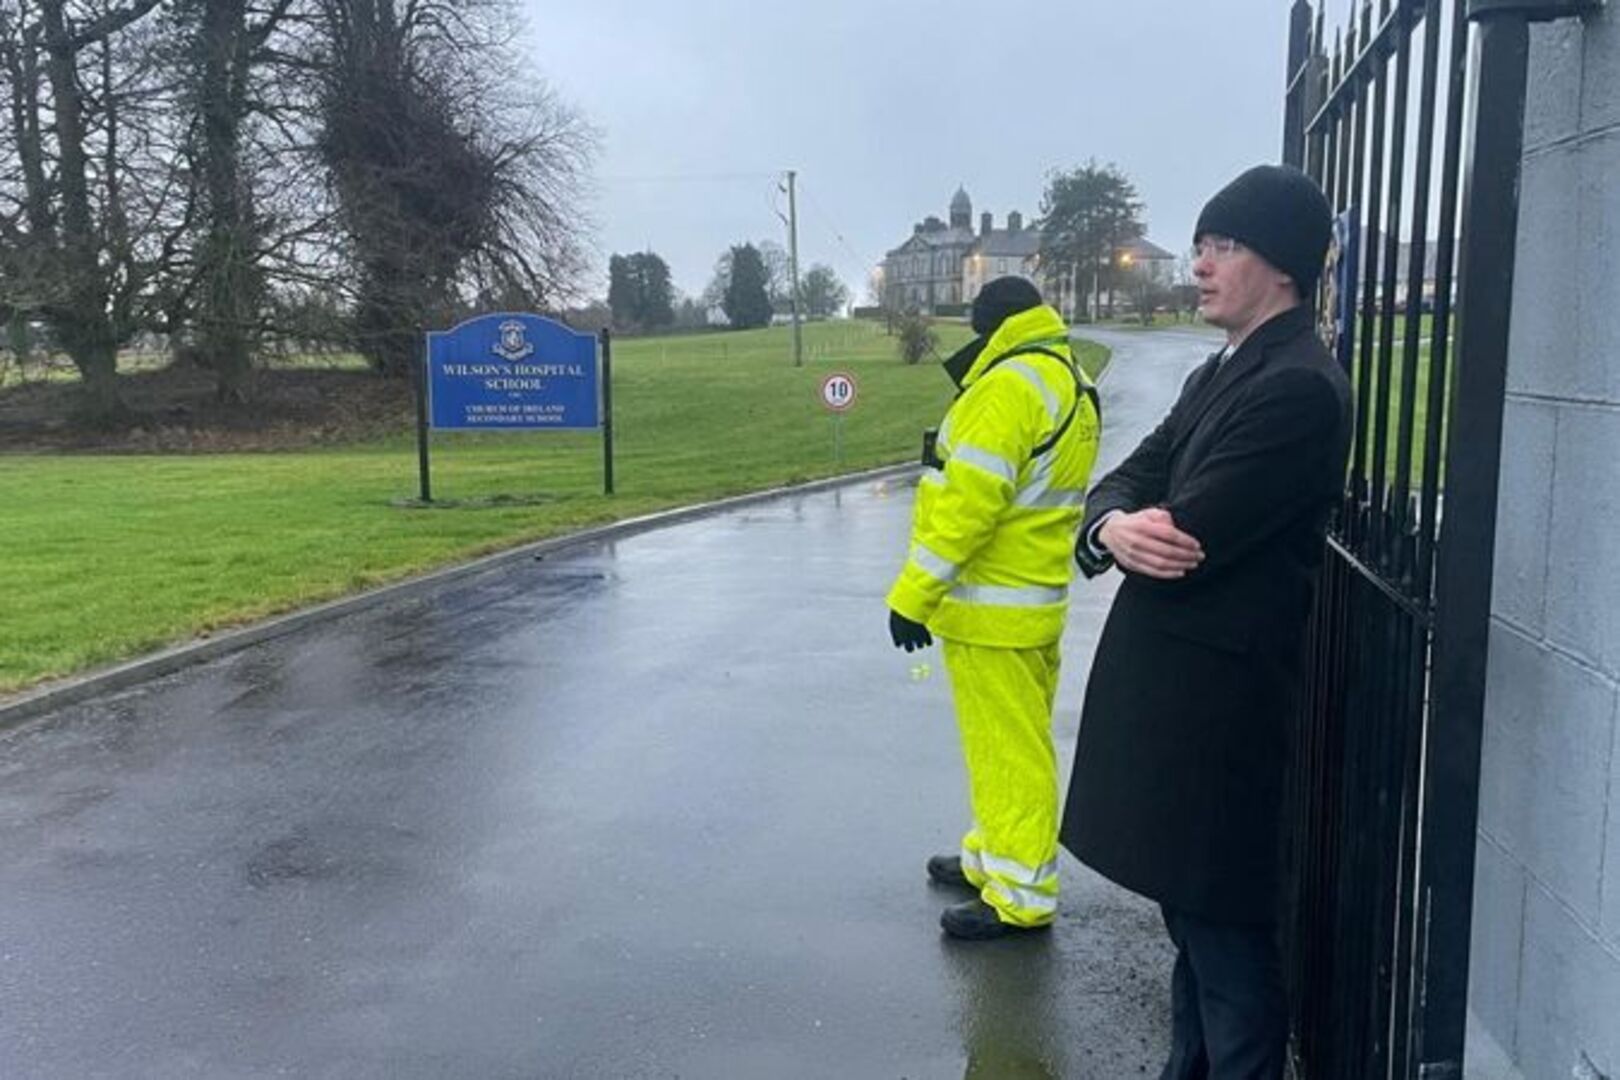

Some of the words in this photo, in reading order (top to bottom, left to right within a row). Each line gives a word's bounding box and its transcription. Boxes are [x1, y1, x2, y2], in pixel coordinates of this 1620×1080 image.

[443, 364, 511, 376] WILSON'S
[515, 364, 584, 376] HOSPITAL
[485, 378, 543, 390] SCHOOL
[830, 381, 848, 398] 10
[508, 404, 520, 414] OF
[523, 404, 565, 414] IRELAND
[466, 414, 523, 423] SECONDARY
[525, 414, 563, 423] SCHOOL
